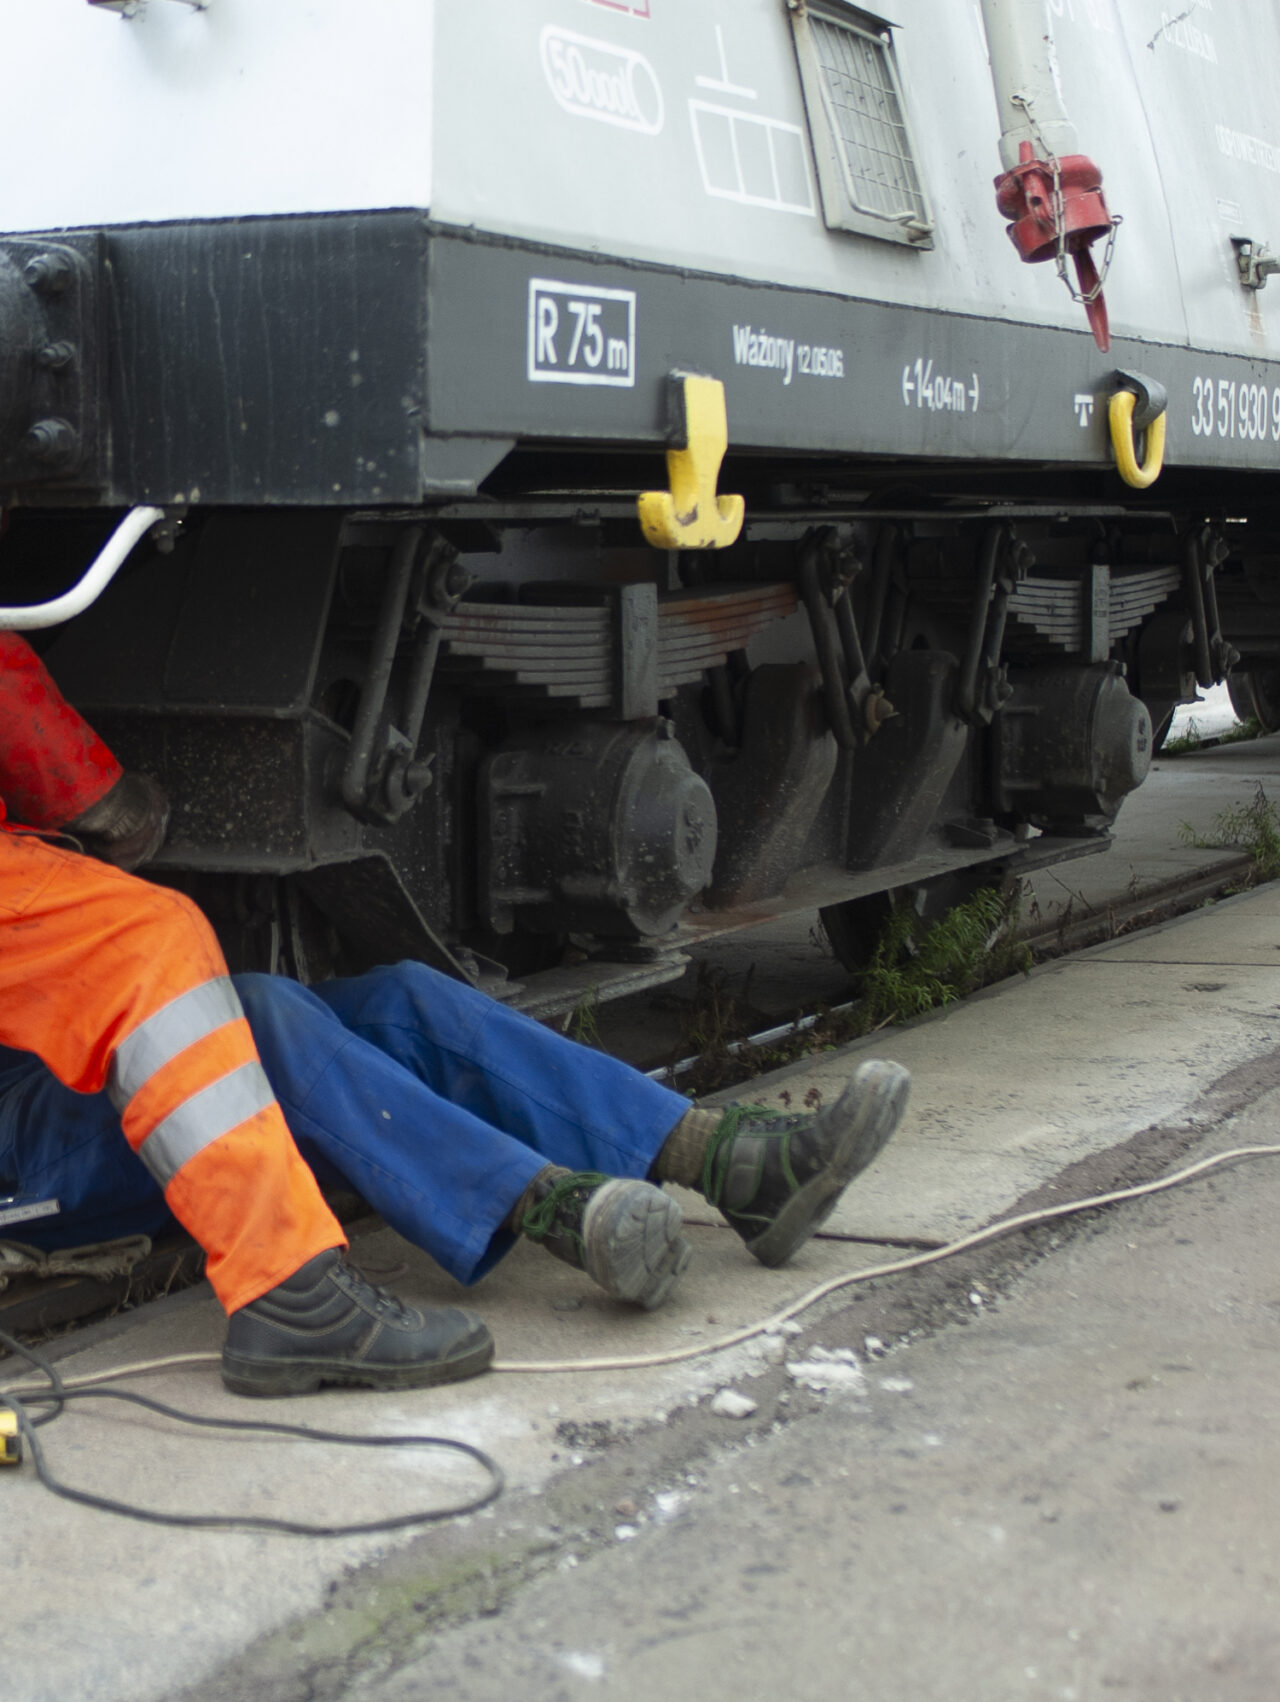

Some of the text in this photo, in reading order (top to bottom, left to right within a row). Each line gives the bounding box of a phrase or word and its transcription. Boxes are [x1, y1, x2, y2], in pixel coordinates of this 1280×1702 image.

[536, 297, 558, 364] R
[733, 324, 795, 385] Ważony
[1191, 376, 1214, 436] 33
[1217, 379, 1236, 438] 51
[1238, 383, 1268, 440] 930
